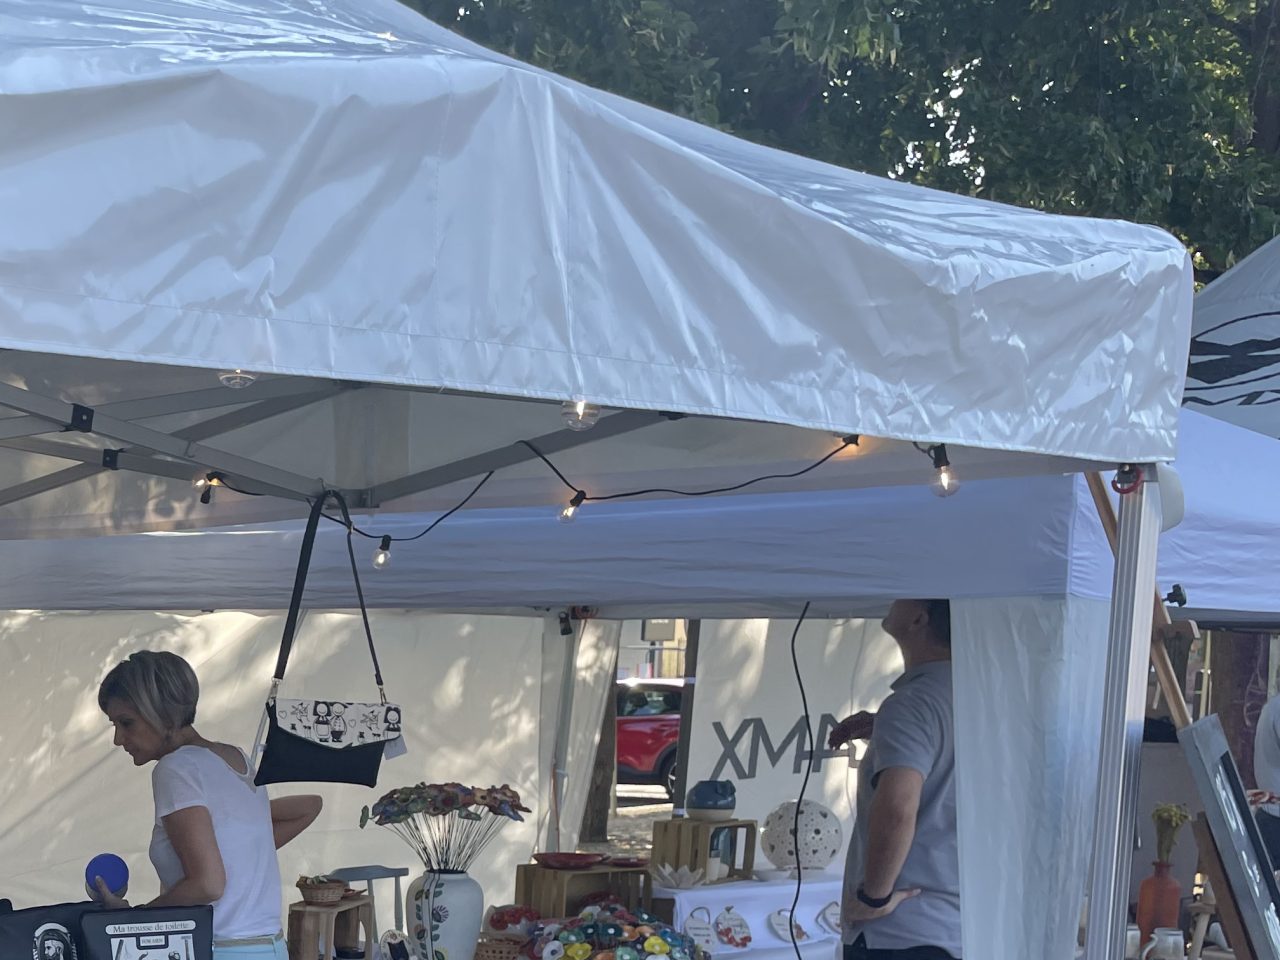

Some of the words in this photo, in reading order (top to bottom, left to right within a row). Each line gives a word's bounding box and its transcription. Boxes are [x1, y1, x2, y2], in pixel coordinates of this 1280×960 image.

[113, 925, 125, 933] Ma
[127, 924, 153, 932] trousse
[155, 923, 163, 931] de
[165, 922, 189, 930] toilette
